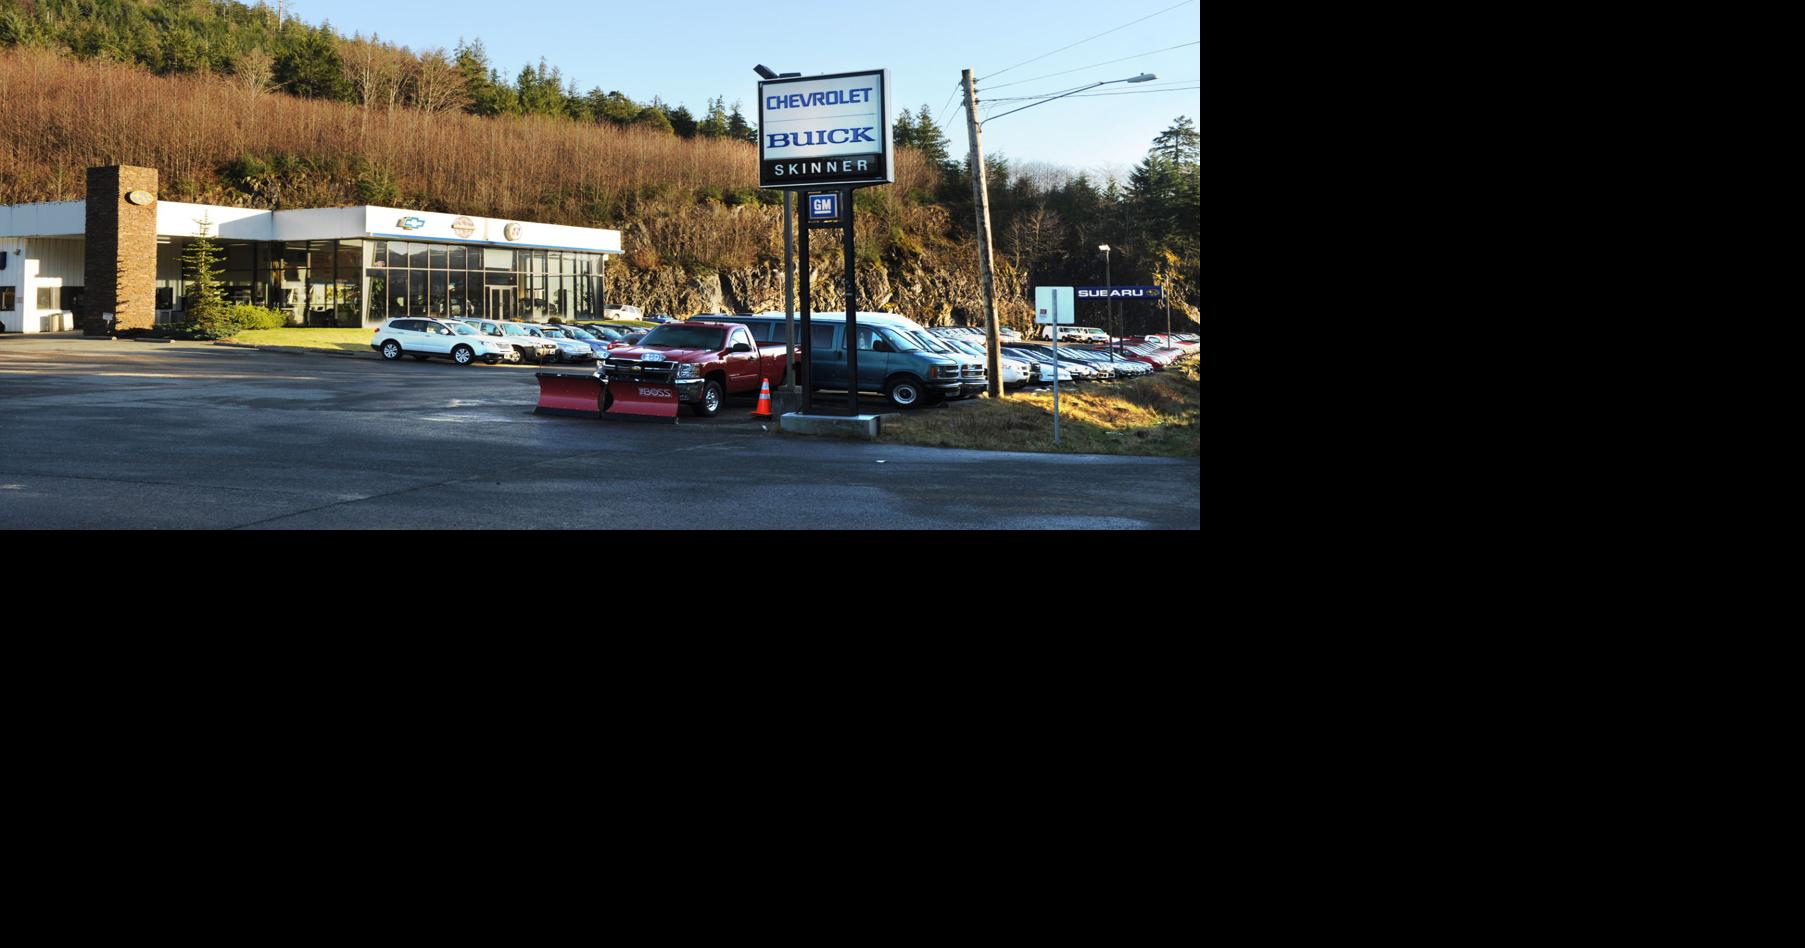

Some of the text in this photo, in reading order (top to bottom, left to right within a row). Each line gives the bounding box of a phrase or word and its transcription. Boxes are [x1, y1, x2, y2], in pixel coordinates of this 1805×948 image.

[766, 87, 873, 110] CHEVROLET
[766, 126, 876, 149] BUICK
[774, 159, 868, 176] SKINNER
[813, 198, 832, 210] GM
